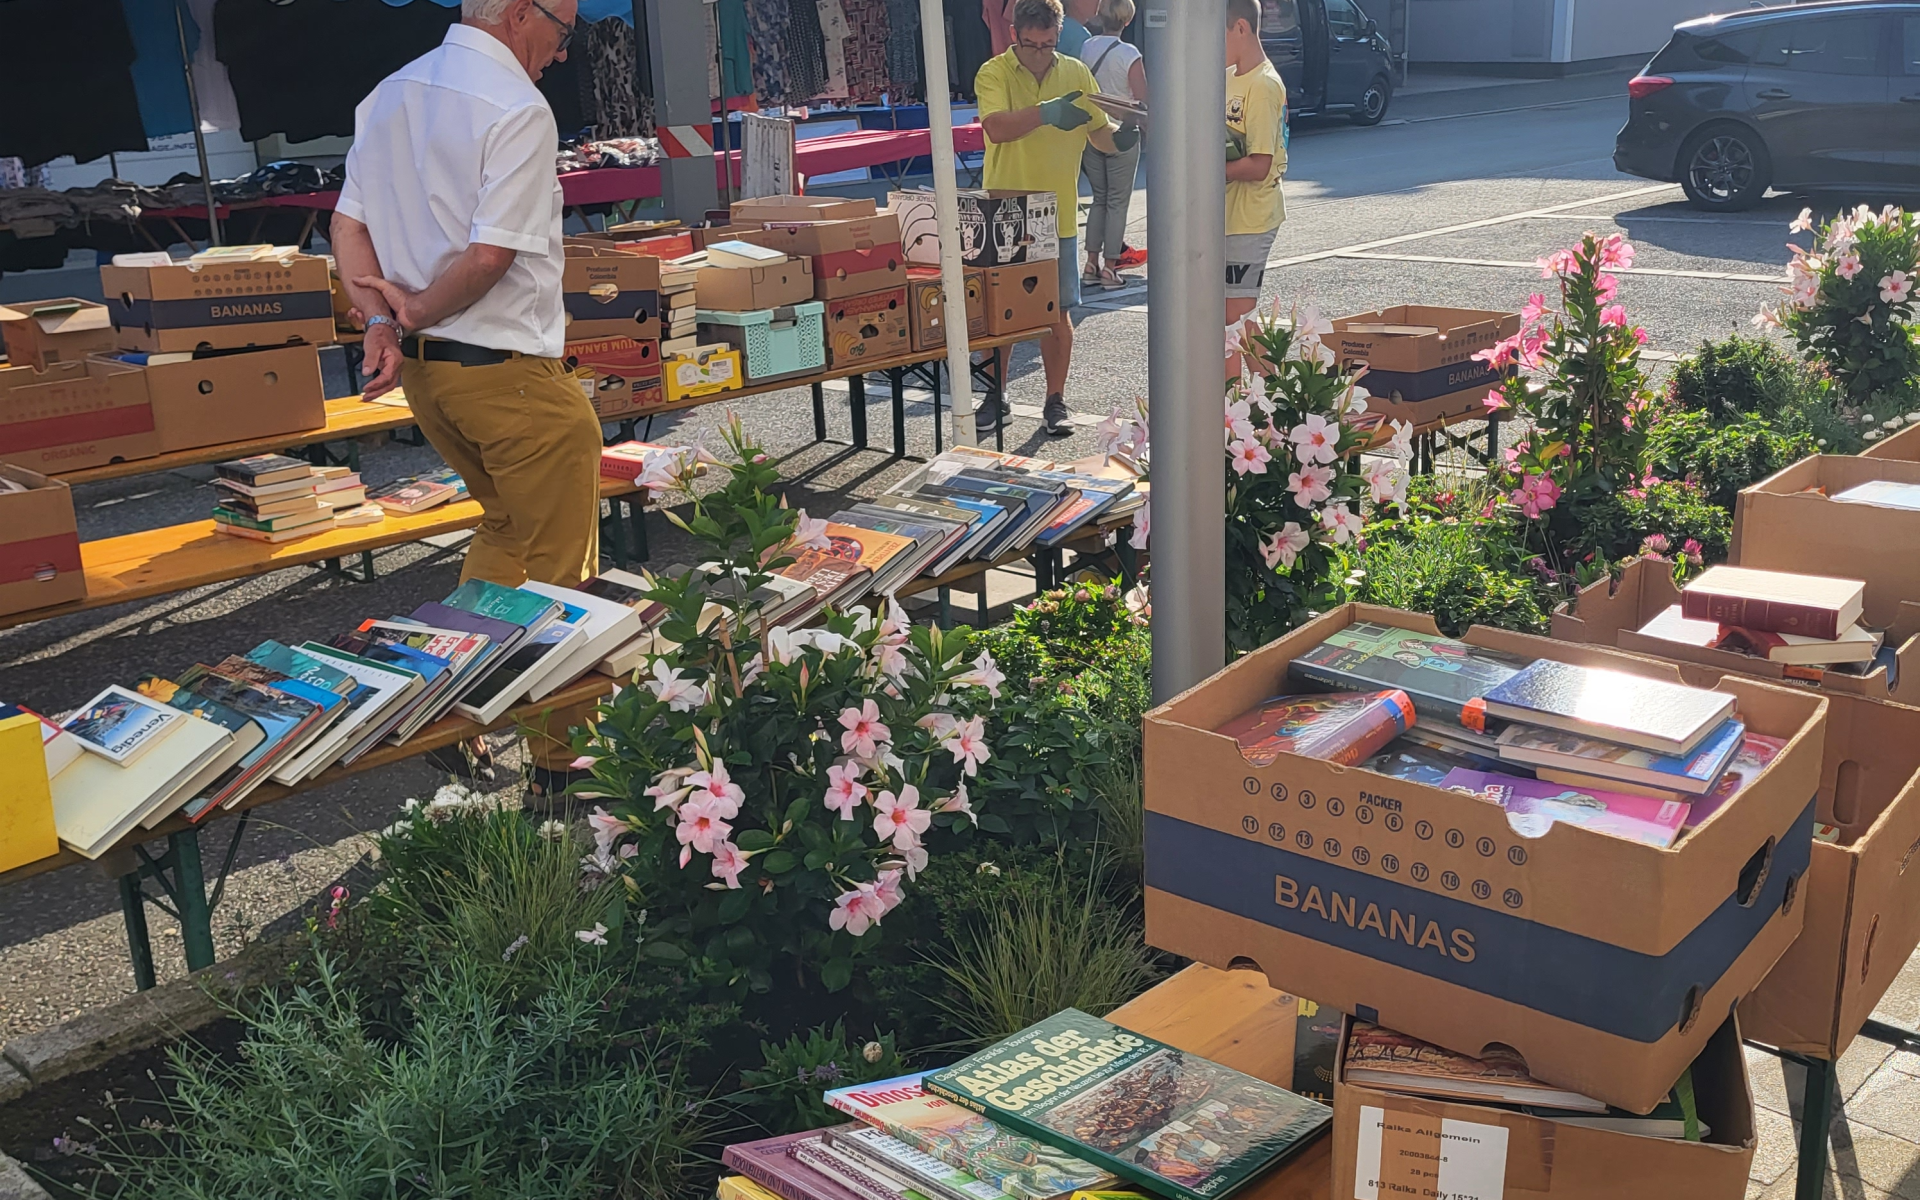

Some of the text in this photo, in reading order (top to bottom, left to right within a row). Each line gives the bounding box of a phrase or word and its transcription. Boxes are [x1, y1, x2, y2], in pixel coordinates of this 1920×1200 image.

[210, 302, 283, 318] BANANAS
[1341, 340, 1365, 349] Produce
[1342, 348, 1370, 357] Colombia
[1448, 364, 1491, 386] BANANAS
[631, 387, 663, 407] Dole
[41, 445, 97, 462] ORGANIC
[111, 714, 172, 754] Venedig
[1359, 791, 1403, 812] PACKER
[1274, 874, 1477, 963] BANANAS
[934, 1028, 1044, 1082] Clapham Franklin Townson
[954, 1029, 1091, 1098] Atlas der
[984, 1032, 1145, 1111] Geschichte
[1020, 1105, 1036, 1118] vom
[1035, 1094, 1060, 1112] Beginn
[1057, 1088, 1072, 1100] der
[1069, 1074, 1094, 1093] Neuzeit
[1092, 1071, 1105, 1082] bis
[1127, 1050, 1142, 1063] des
[846, 1084, 934, 1109] Dinosa
[923, 1099, 949, 1109] von
[927, 1082, 987, 1114] Atlas der Geschichte
[842, 1103, 854, 1114] von
[854, 1108, 885, 1131] Dinosaurier
[1415, 1128, 1481, 1144] Allgemein
[767, 1173, 781, 1189] UND
[1410, 1168, 1421, 1176] 28
[1193, 1174, 1229, 1196] Delphin
[1368, 1179, 1386, 1189] 813
[1422, 1188, 1449, 1200] Daily
